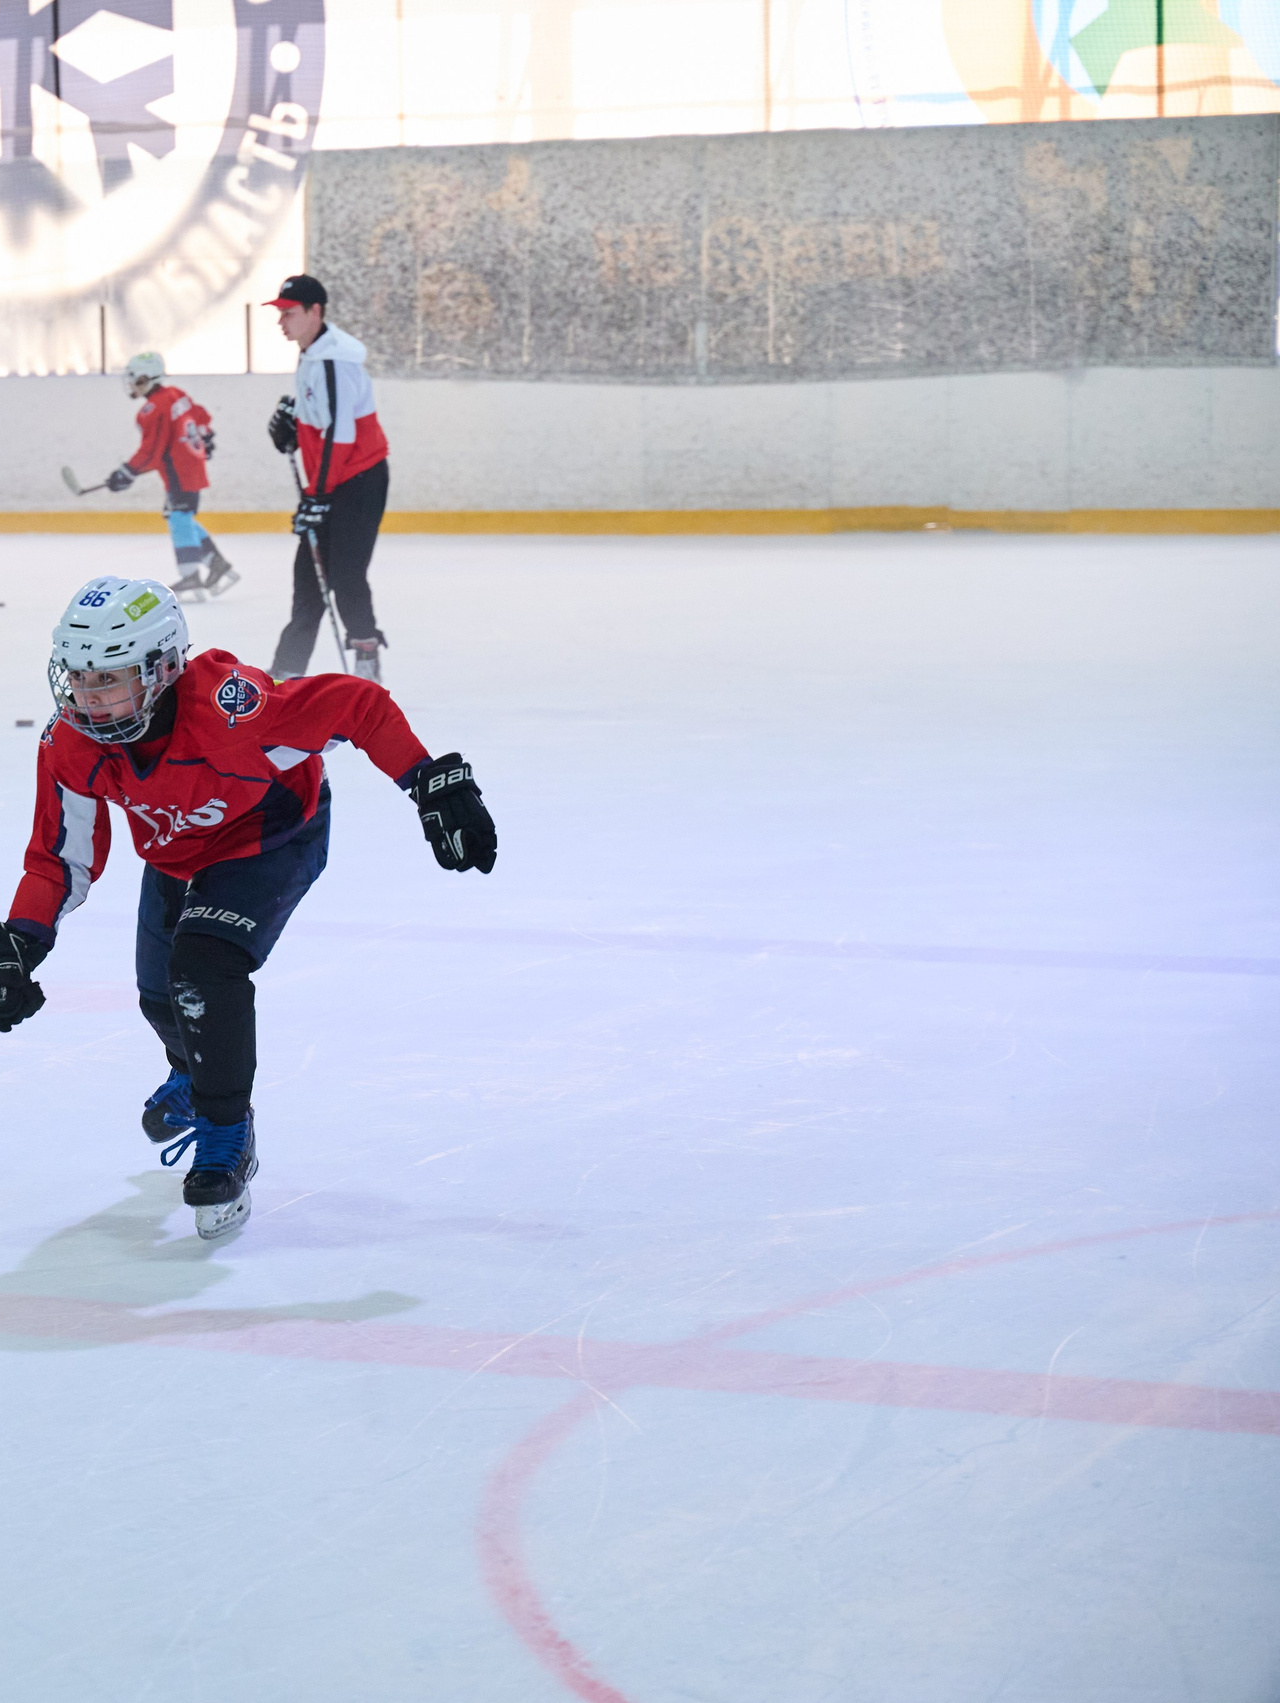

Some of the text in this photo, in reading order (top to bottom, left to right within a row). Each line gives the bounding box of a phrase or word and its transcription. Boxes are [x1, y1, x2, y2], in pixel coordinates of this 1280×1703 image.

[79, 590, 111, 607] 86
[220, 684, 237, 704] 10
[236, 680, 247, 712] STEPS
[179, 906, 257, 932] BAUER
